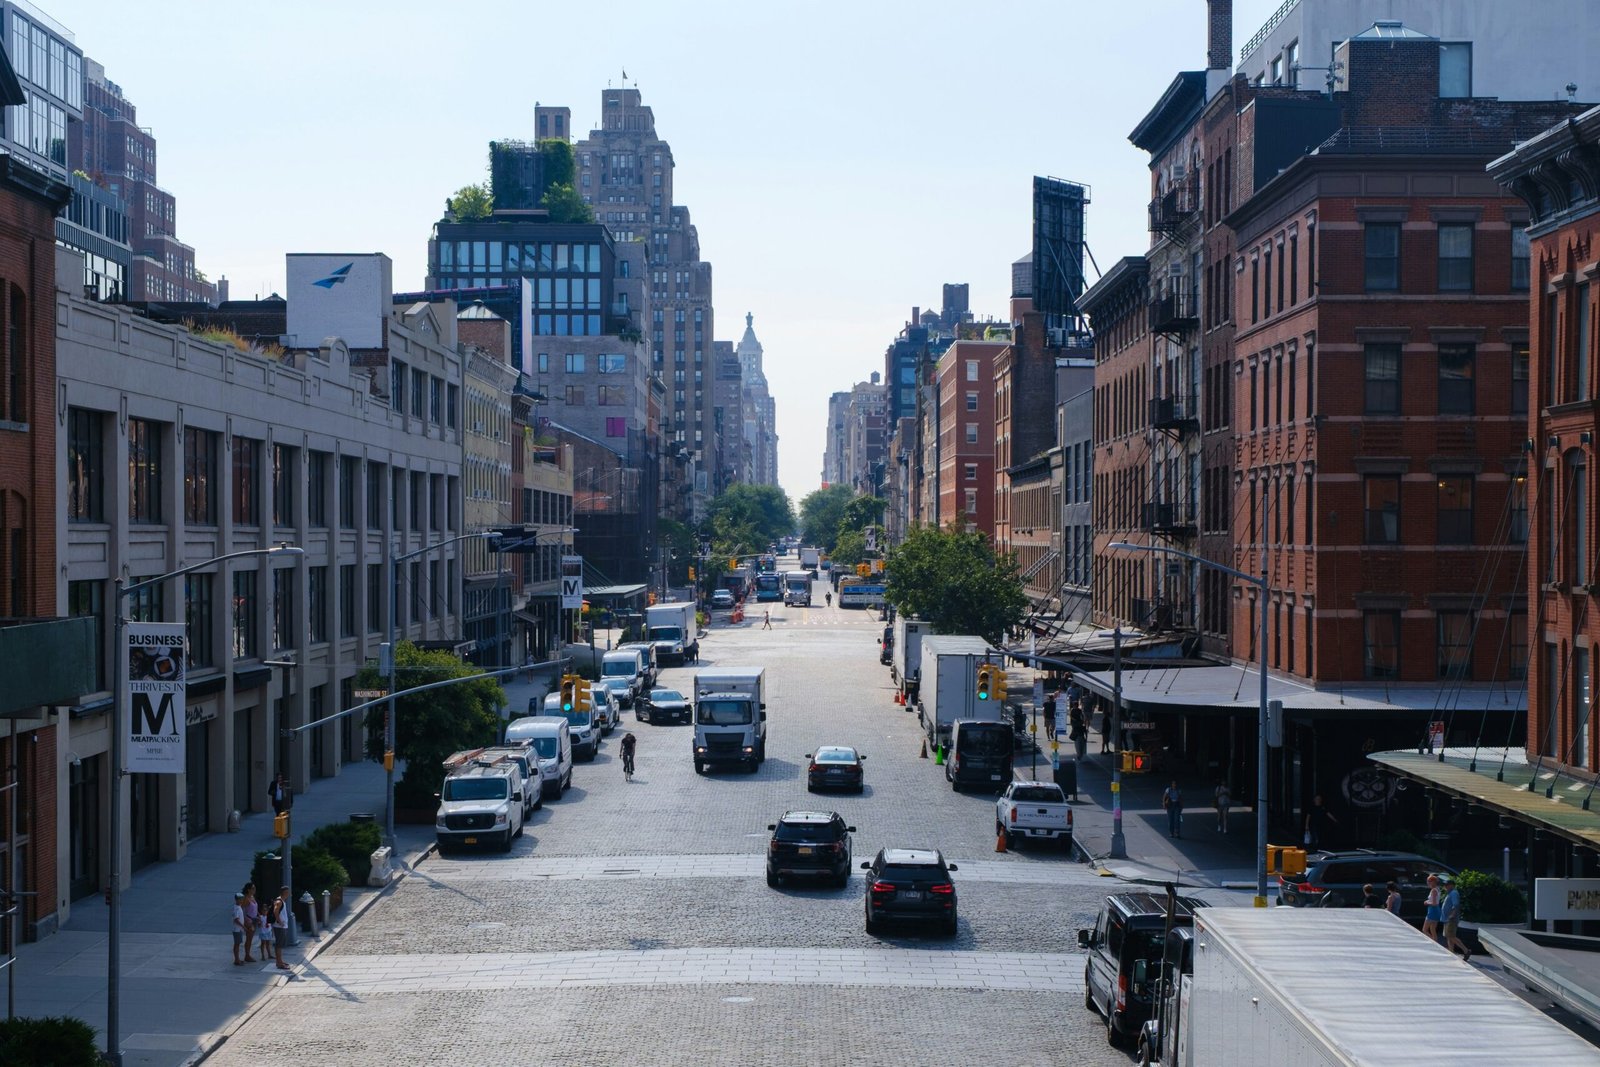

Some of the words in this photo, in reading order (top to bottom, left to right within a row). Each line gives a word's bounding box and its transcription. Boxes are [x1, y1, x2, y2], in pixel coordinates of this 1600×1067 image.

[563, 580, 580, 596] M
[128, 634, 184, 646] BUSINESS
[129, 682, 171, 692] THRIVES
[173, 682, 184, 692] IN
[131, 692, 180, 735] M
[130, 735, 181, 744] MEATPACKING
